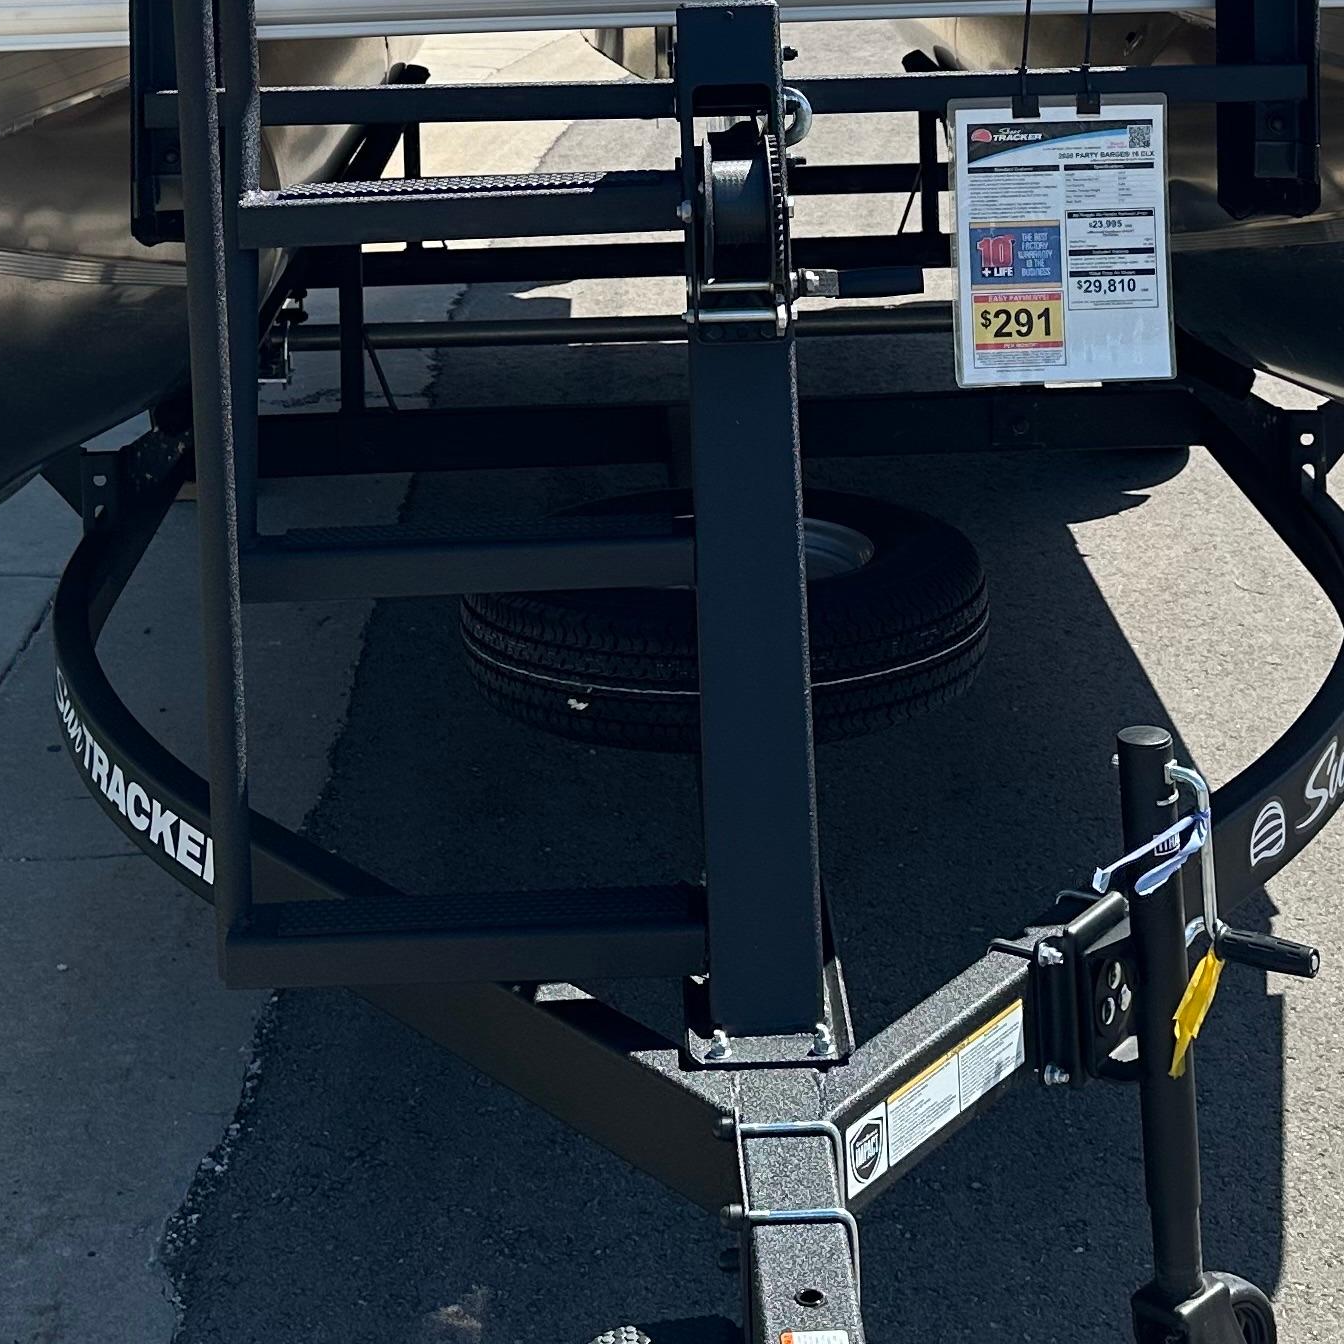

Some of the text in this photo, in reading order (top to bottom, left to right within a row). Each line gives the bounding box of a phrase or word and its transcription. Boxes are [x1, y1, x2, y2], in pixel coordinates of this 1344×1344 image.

[992, 133, 1042, 142] TRACKER
[1022, 241, 1048, 250] FACTORY
[994, 267, 1013, 277] LIFE
[1076, 278, 1136, 295] $29,810
[988, 295, 1008, 303] EASY
[980, 307, 1051, 338] $291
